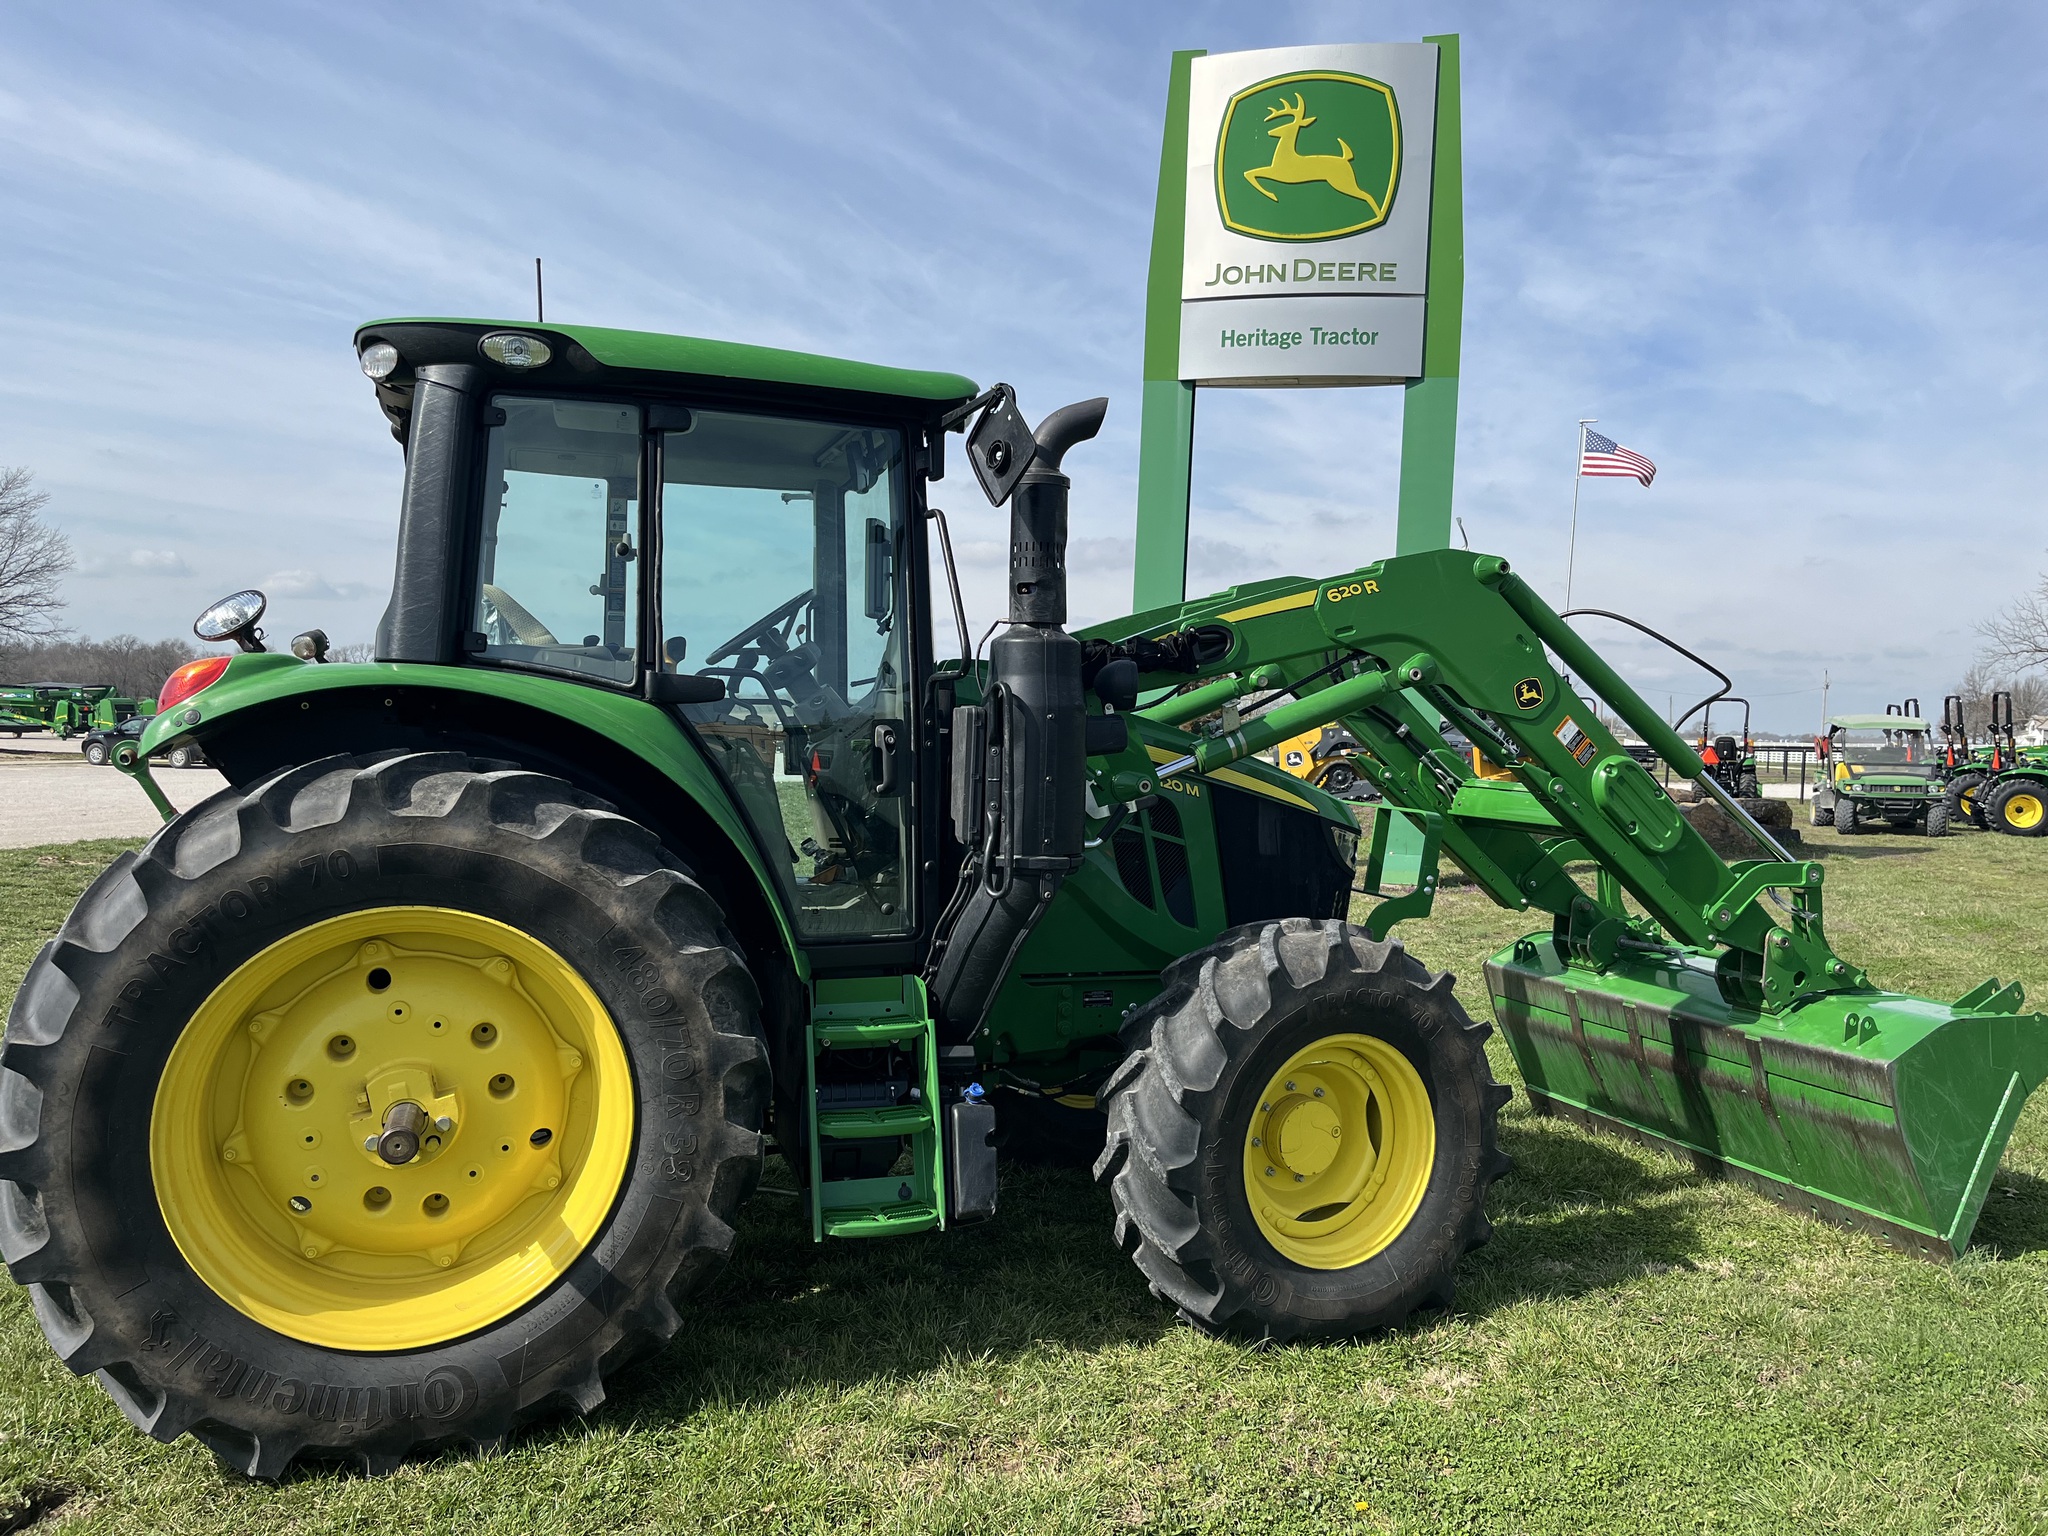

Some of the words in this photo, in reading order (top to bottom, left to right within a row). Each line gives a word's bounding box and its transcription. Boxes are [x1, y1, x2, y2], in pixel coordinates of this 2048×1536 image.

[1205, 263, 1287, 287] JOHN
[1293, 259, 1397, 282] DEERE
[1221, 329, 1303, 350] Heritage
[1310, 327, 1379, 346] Tractor
[1327, 583, 1362, 602] 620
[1363, 580, 1380, 594] R
[1185, 782, 1200, 798] M
[101, 875, 282, 1028] TRACTOR
[299, 849, 358, 889] 70
[1410, 1003, 1435, 1032] 70
[666, 1093, 700, 1119] R
[659, 1131, 698, 1182] 38
[164, 1331, 479, 1435] Continental
